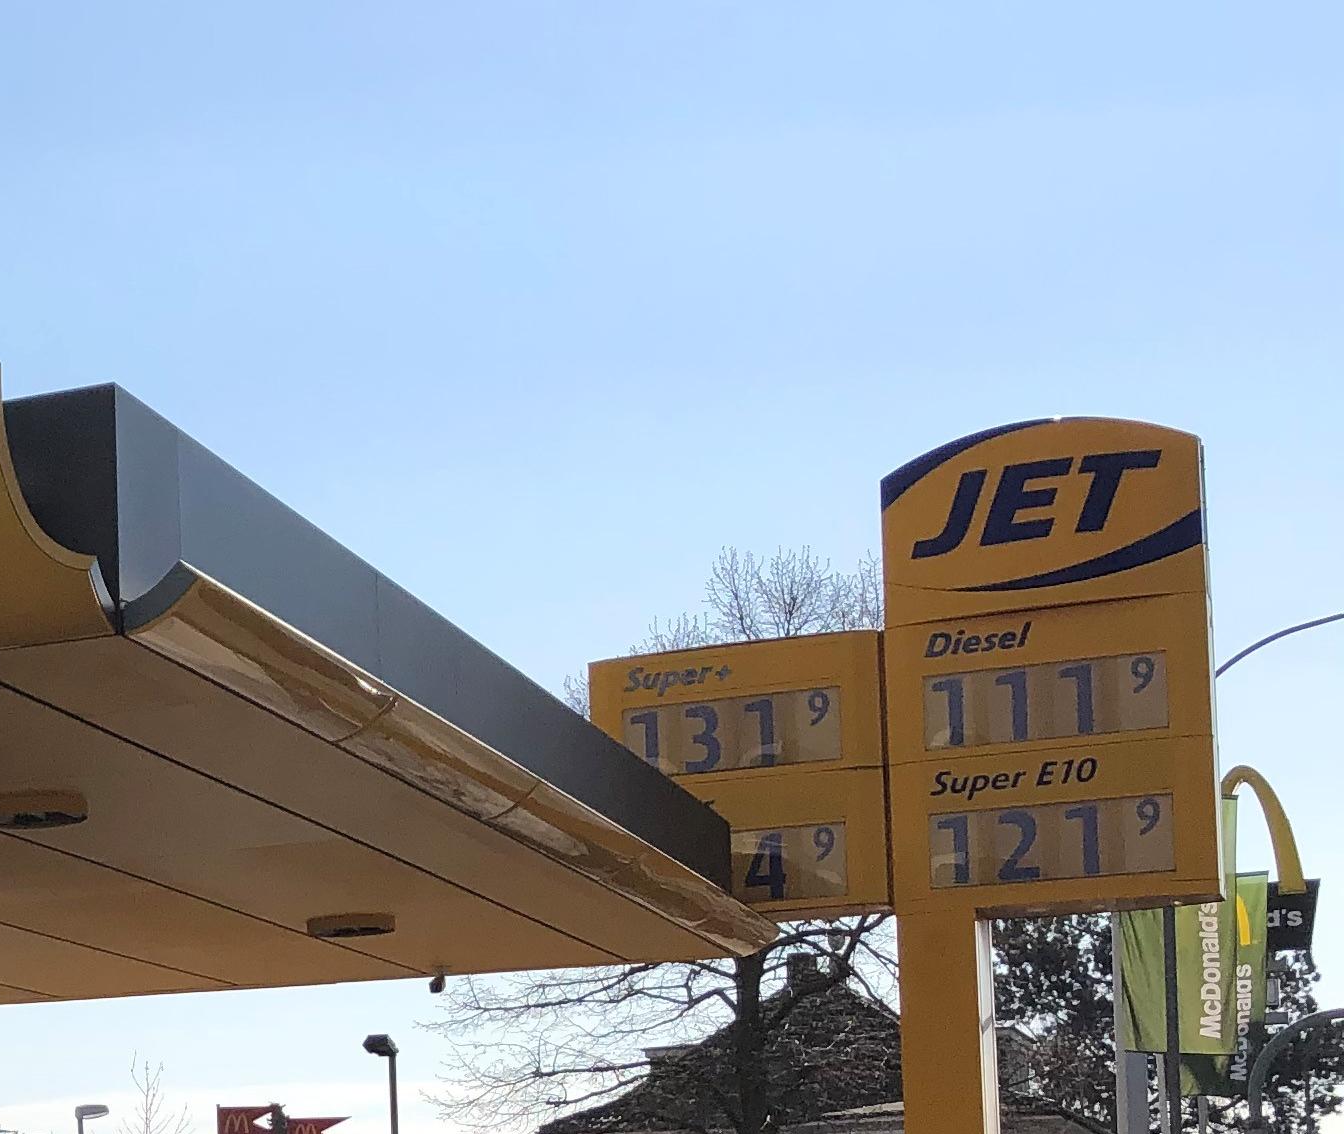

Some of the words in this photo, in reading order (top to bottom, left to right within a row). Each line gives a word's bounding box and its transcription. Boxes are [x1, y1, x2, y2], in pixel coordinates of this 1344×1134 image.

[912, 450, 1162, 560] JET
[925, 621, 1031, 657] Diesel
[929, 770, 1026, 800] Super
[1036, 757, 1098, 788] E10
